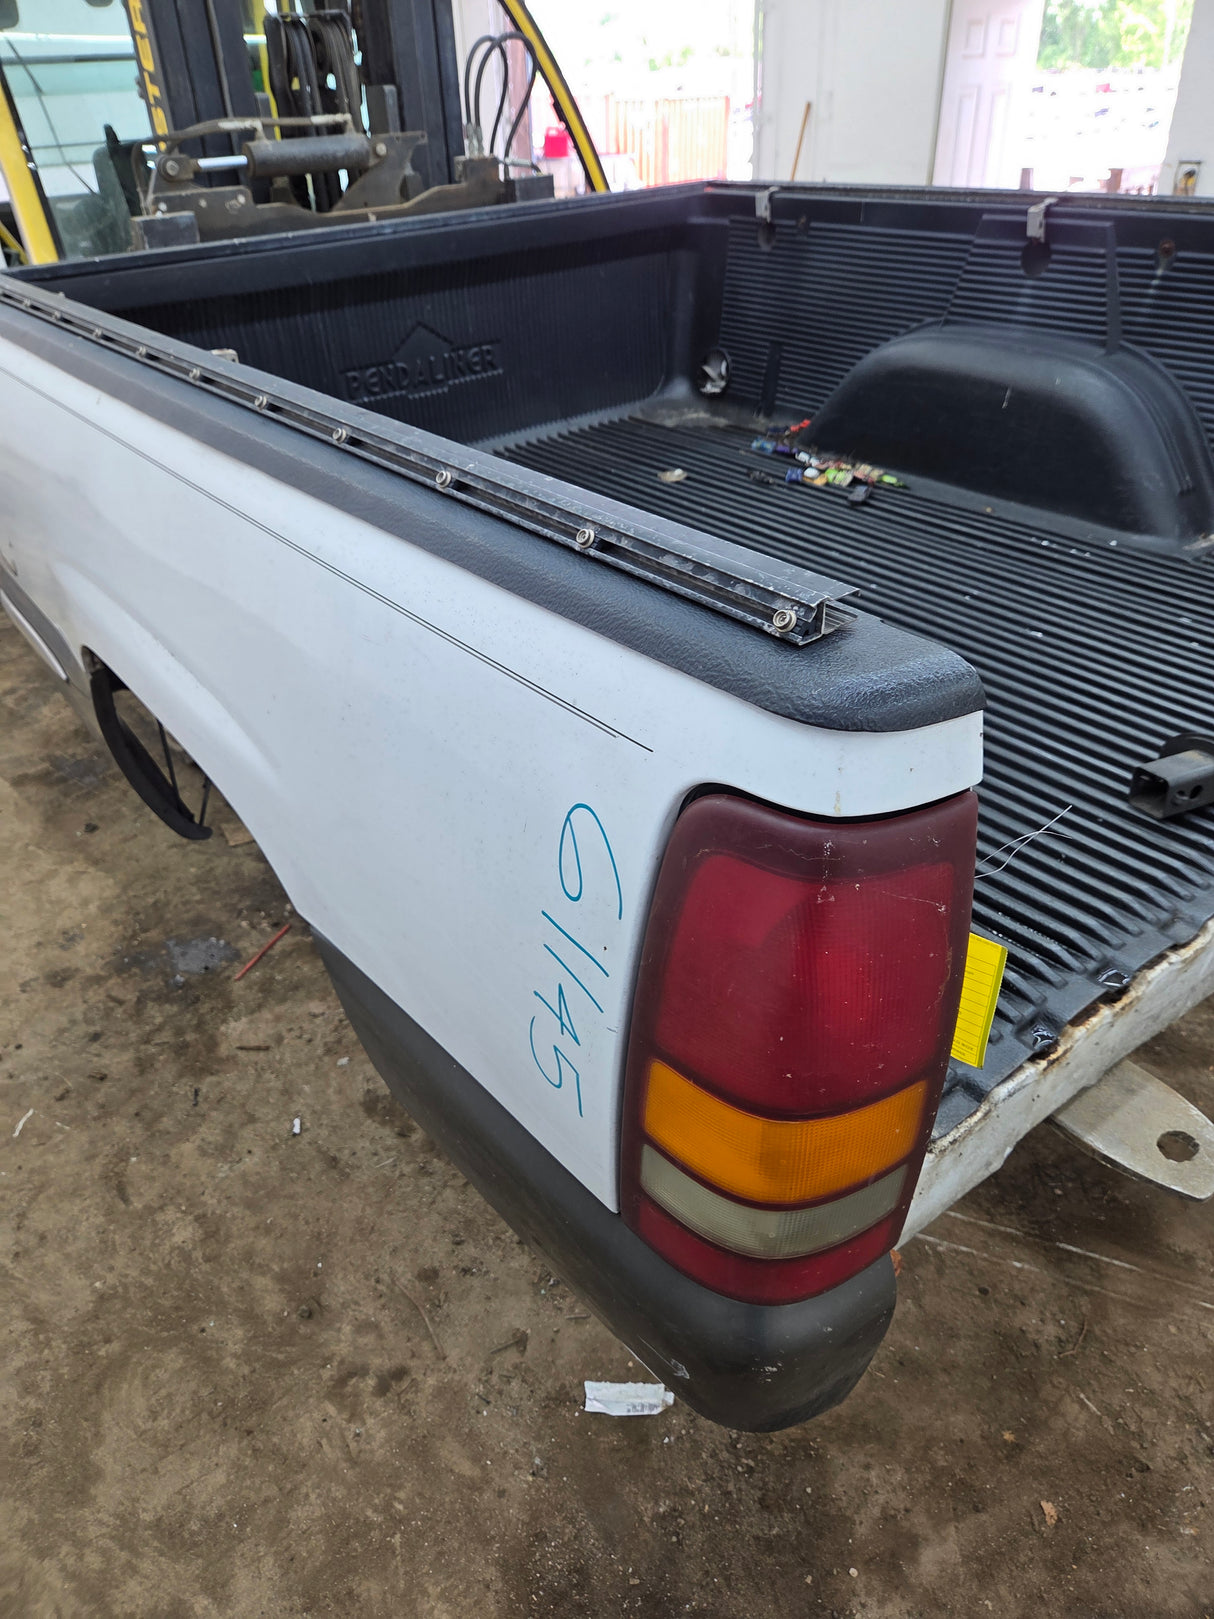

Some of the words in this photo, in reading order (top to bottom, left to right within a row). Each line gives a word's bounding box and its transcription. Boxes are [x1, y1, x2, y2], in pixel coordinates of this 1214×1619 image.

[128, 0, 169, 152] STER
[345, 344, 498, 398] PENDALINER
[530, 803, 623, 1117] 61145
